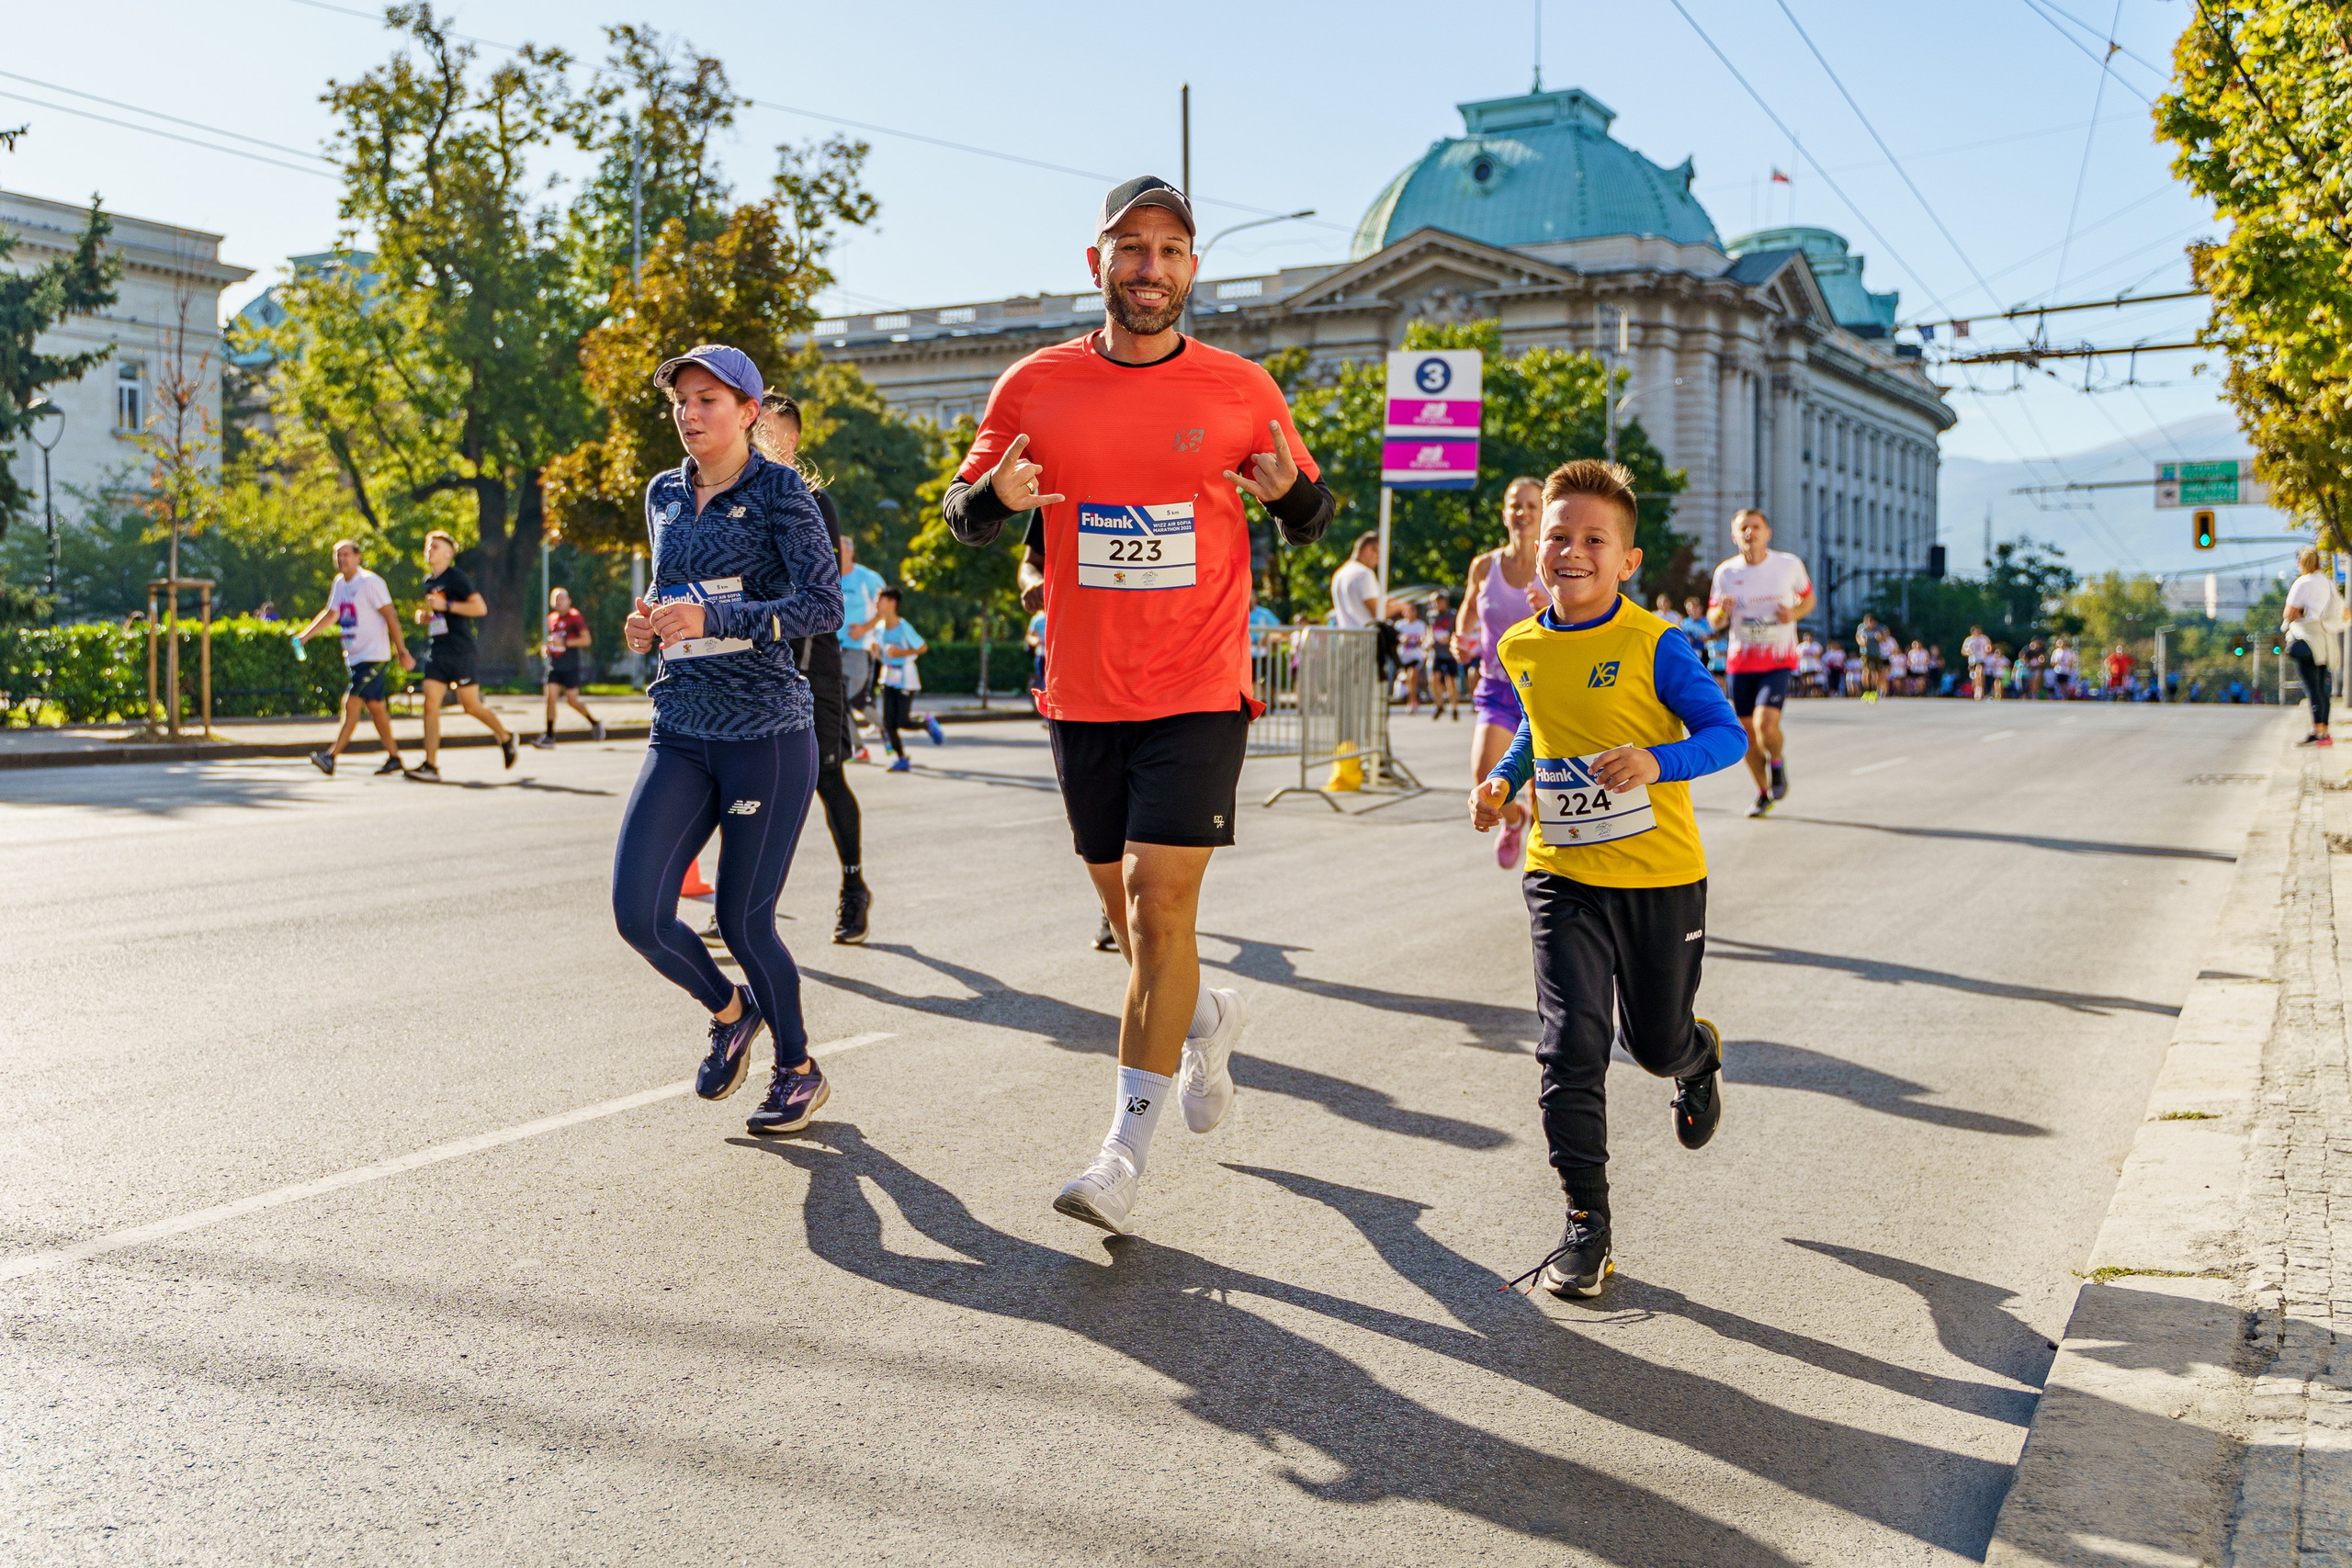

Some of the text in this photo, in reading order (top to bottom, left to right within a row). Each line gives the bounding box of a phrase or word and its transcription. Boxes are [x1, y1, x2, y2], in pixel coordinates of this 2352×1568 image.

[1422, 362, 1445, 390] 3
[1081, 512, 1134, 529] Fibank
[1109, 539, 1162, 562] 223
[1535, 767, 1575, 783] Fibank
[1556, 788, 1611, 817] 224
[1684, 929, 1702, 942] JAKO
